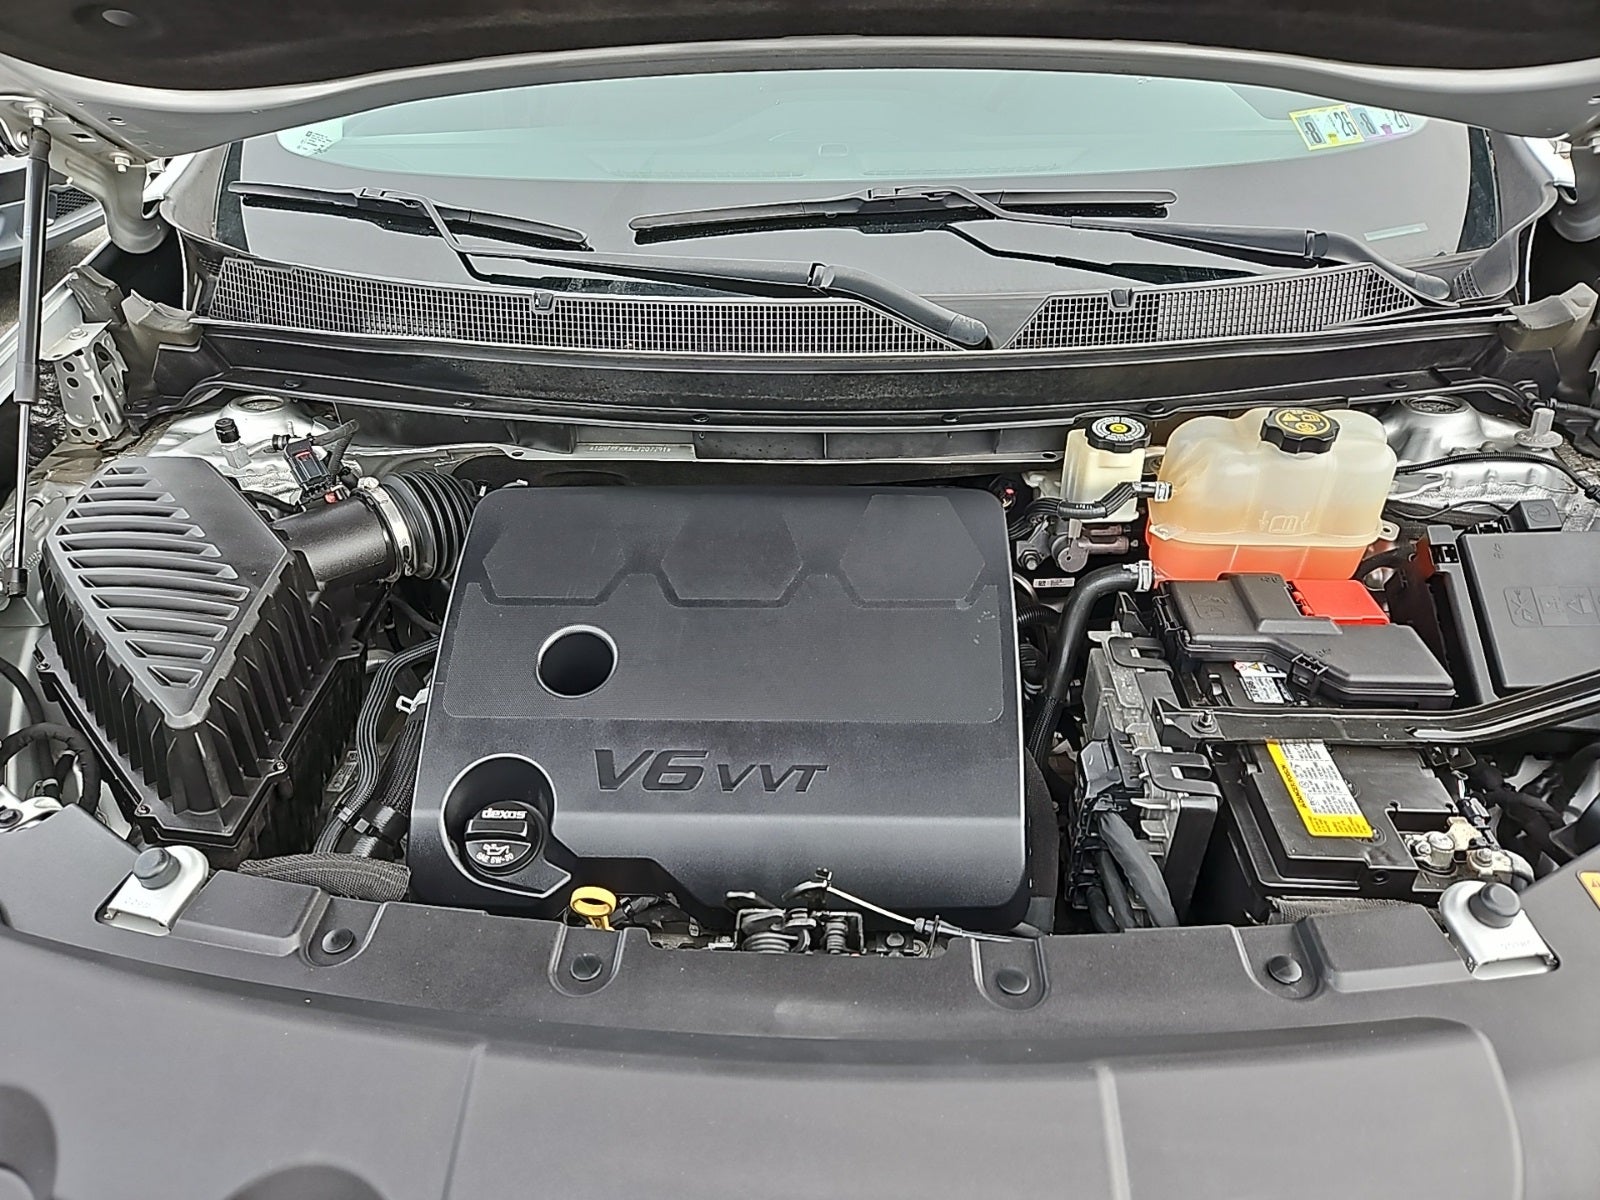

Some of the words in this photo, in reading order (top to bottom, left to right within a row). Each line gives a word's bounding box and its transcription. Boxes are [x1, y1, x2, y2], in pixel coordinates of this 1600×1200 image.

[1304, 121, 1322, 143] 8
[1333, 111, 1357, 137] 26
[1359, 112, 1376, 135] 8
[594, 749, 709, 791] V6
[716, 764, 829, 792] VVT
[481, 807, 528, 819] dexos
